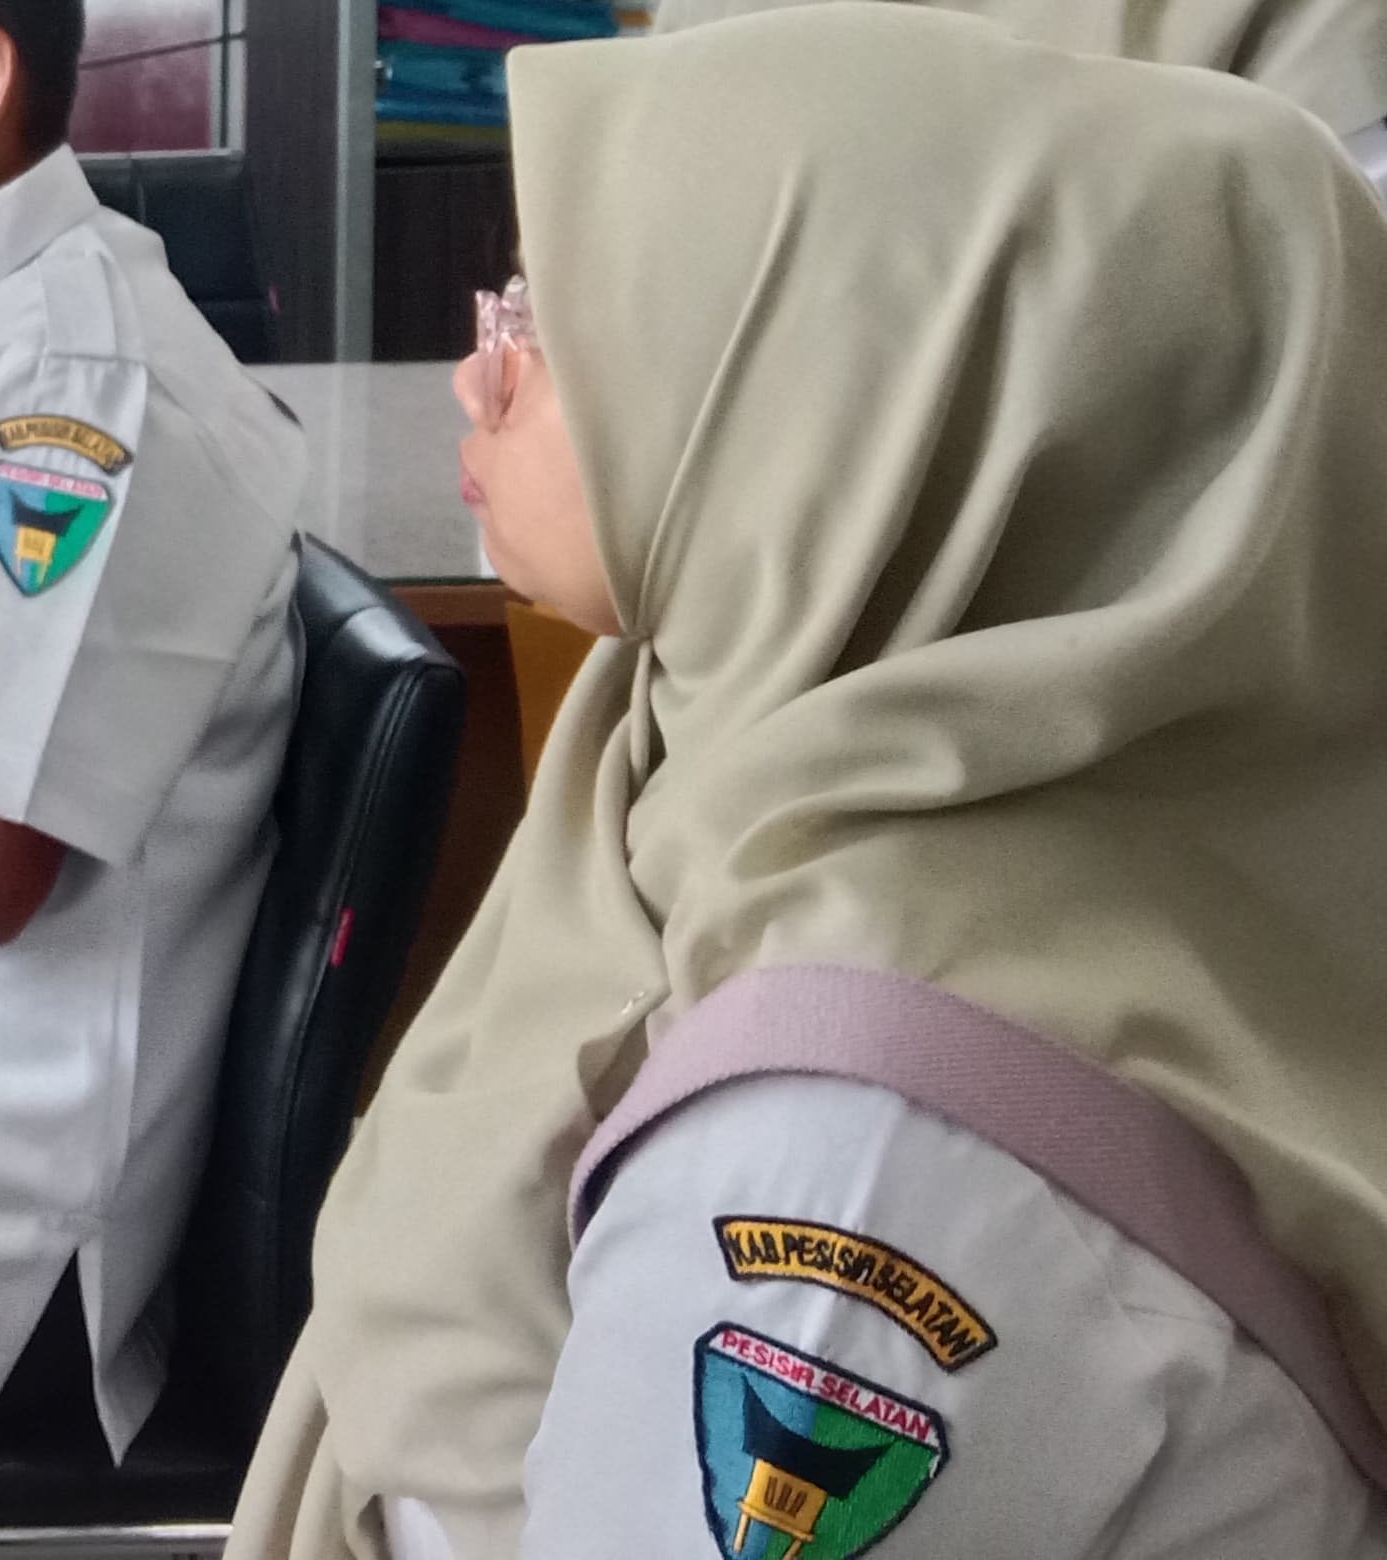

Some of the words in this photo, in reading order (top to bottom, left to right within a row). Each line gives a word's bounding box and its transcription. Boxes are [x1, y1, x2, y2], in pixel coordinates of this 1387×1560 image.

[872, 1265, 978, 1357] SELATAN
[719, 1328, 817, 1391] PESISIR
[819, 1375, 934, 1443] SELATAN
